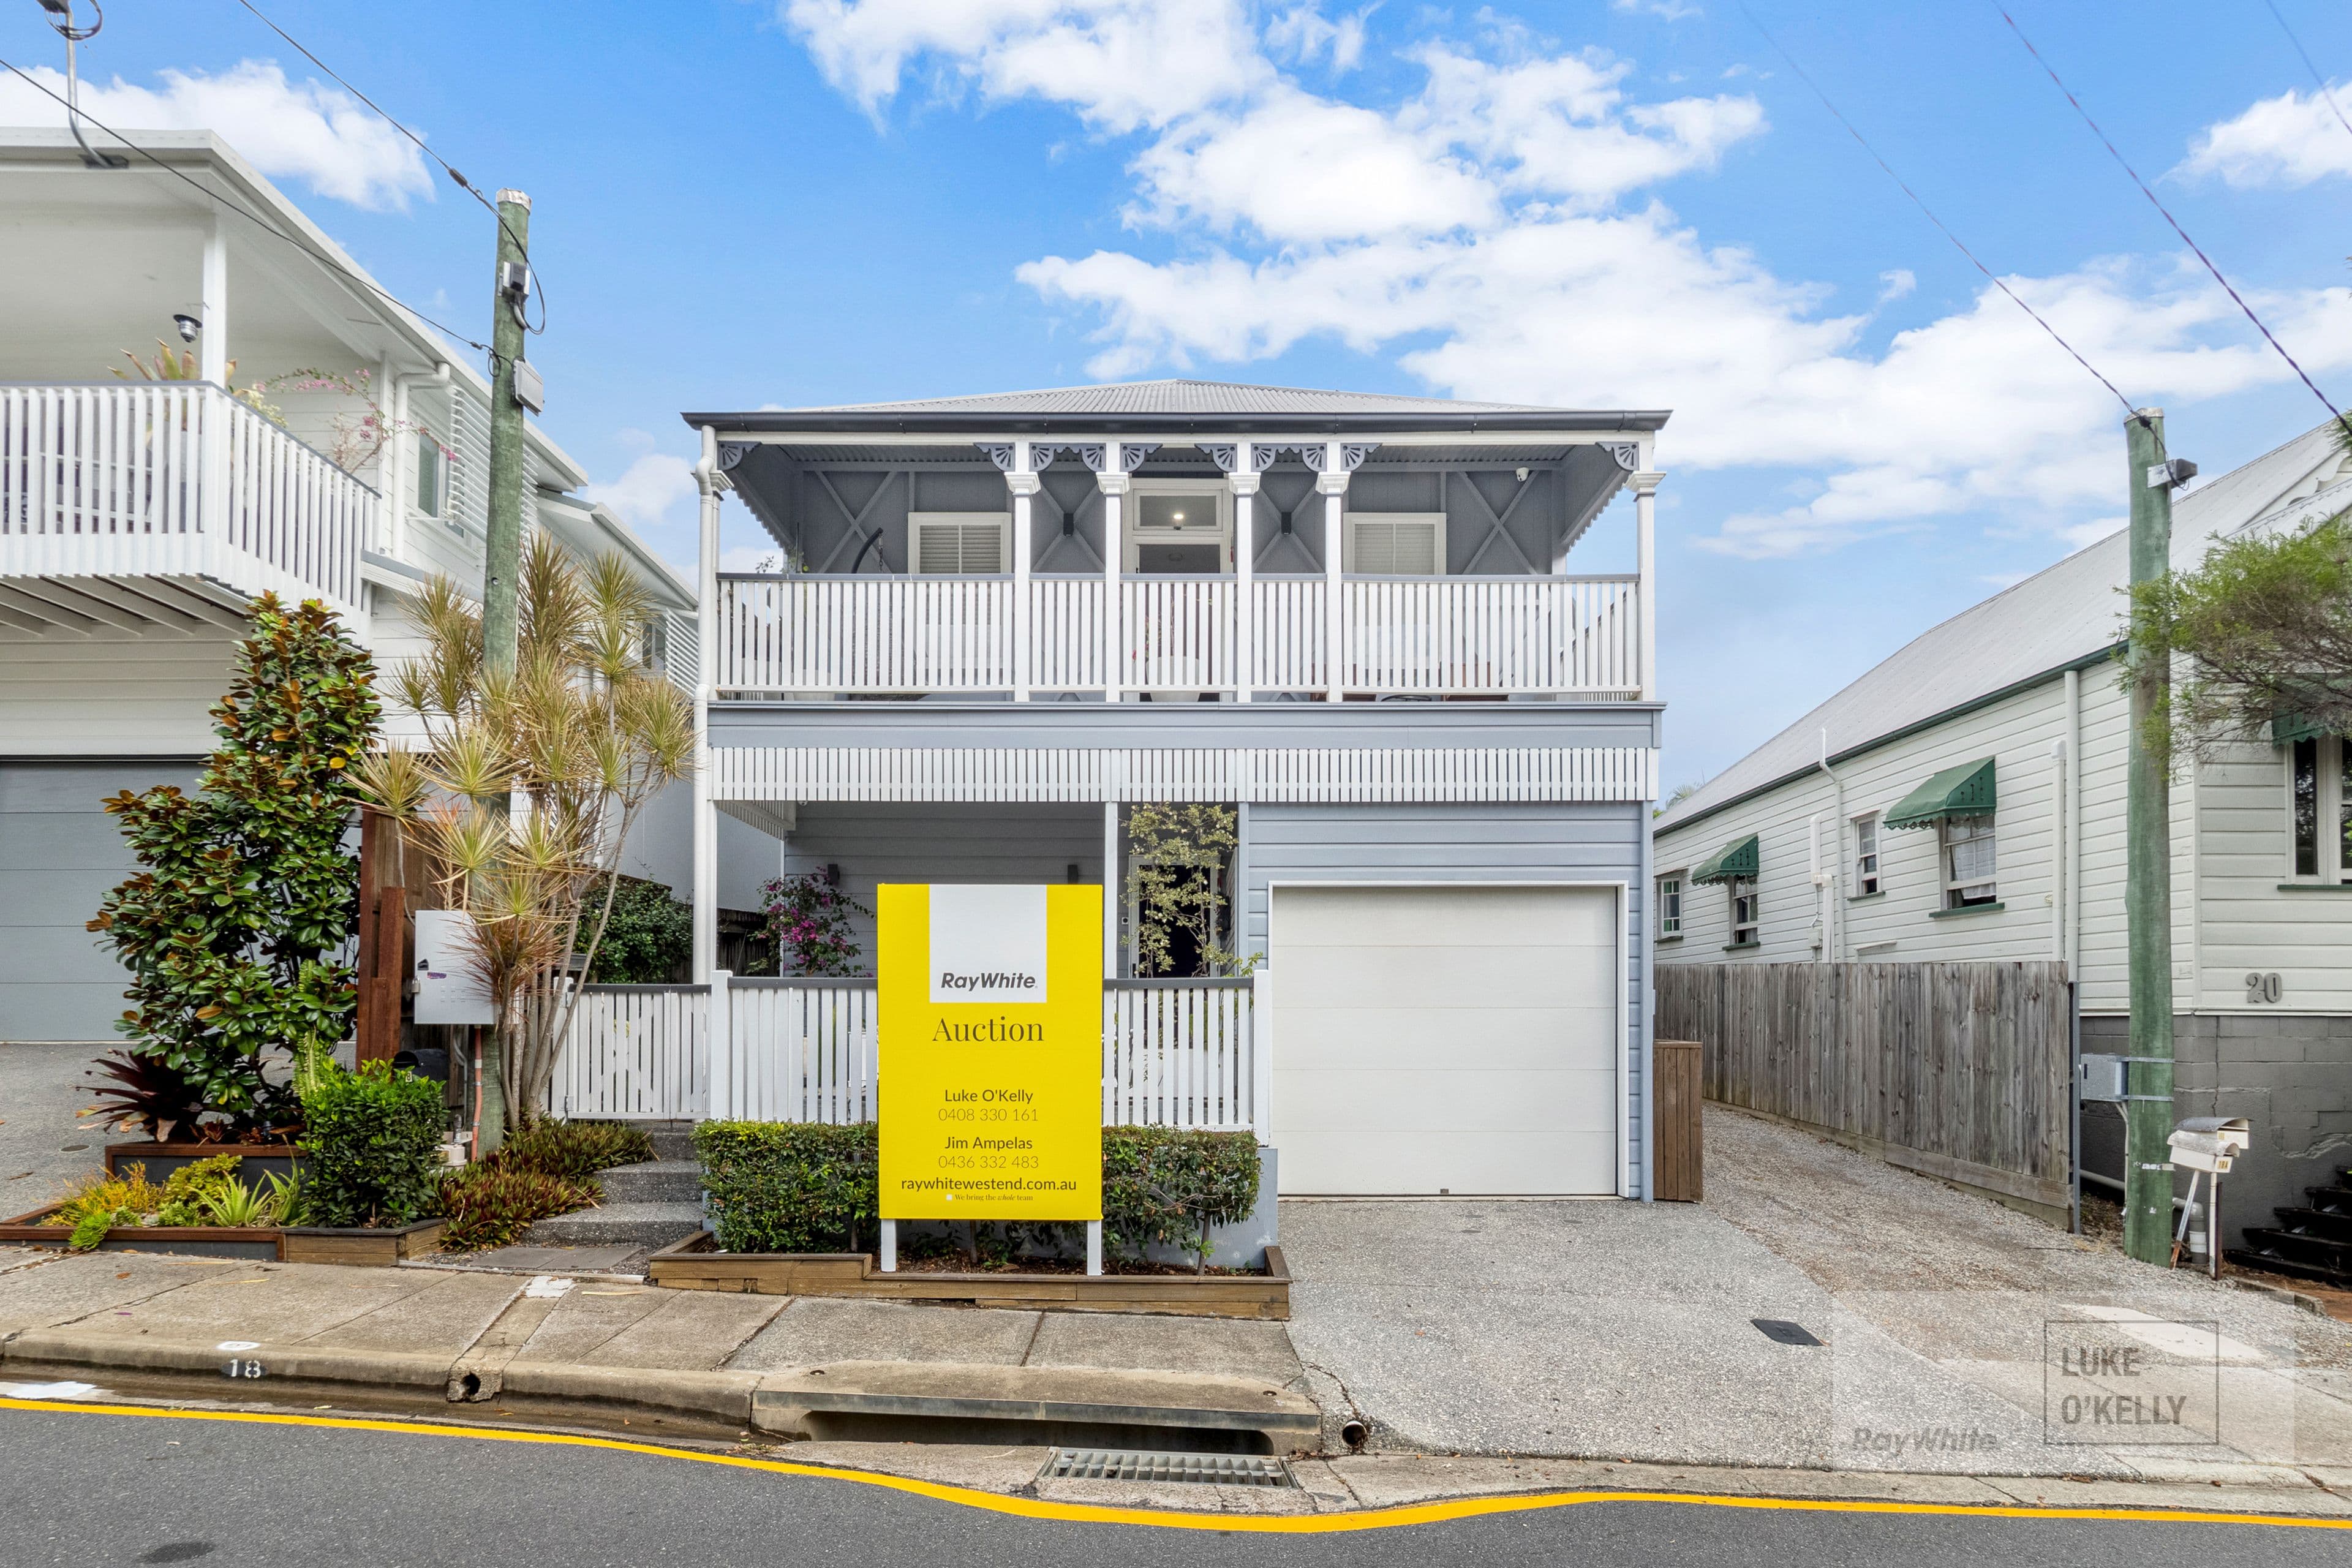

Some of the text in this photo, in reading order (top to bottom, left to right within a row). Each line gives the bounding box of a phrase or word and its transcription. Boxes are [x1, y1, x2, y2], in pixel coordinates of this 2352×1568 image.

[941, 972, 1036, 992] RayWhite
[2246, 972, 2283, 1003] 20
[932, 1016, 1044, 1042] Auction
[944, 1089, 1034, 1104] Luke O'Kelly
[938, 1108, 1039, 1121] 0408 330 161
[944, 1136, 1033, 1152] Jim Ampelas
[938, 1155, 1039, 1169] 0436 332 483
[901, 1177, 1077, 1192] raywhitewestend.com.au
[230, 1359, 262, 1379] 18
